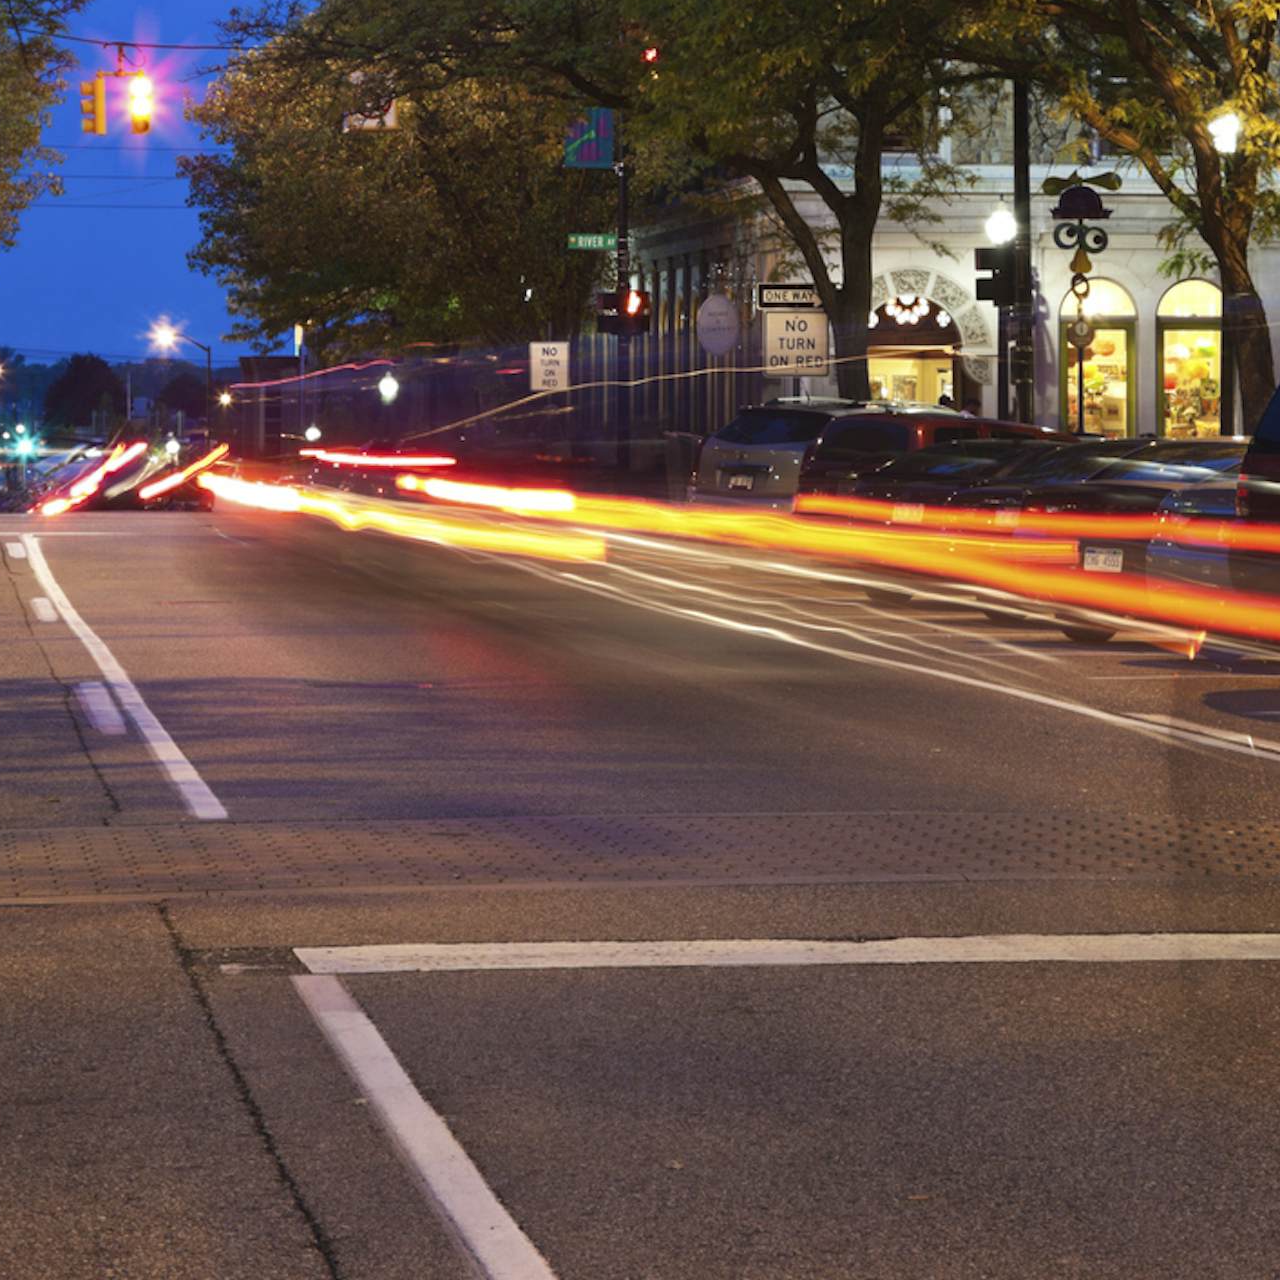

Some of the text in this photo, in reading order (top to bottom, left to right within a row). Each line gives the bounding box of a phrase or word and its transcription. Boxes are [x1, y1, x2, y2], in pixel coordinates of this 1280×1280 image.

[577, 235, 604, 249] RIVER
[765, 290, 814, 301] ONE WAY
[785, 319, 808, 332] NO
[778, 337, 816, 350] TURN
[542, 346, 558, 357] NO
[769, 355, 824, 369] ON RED
